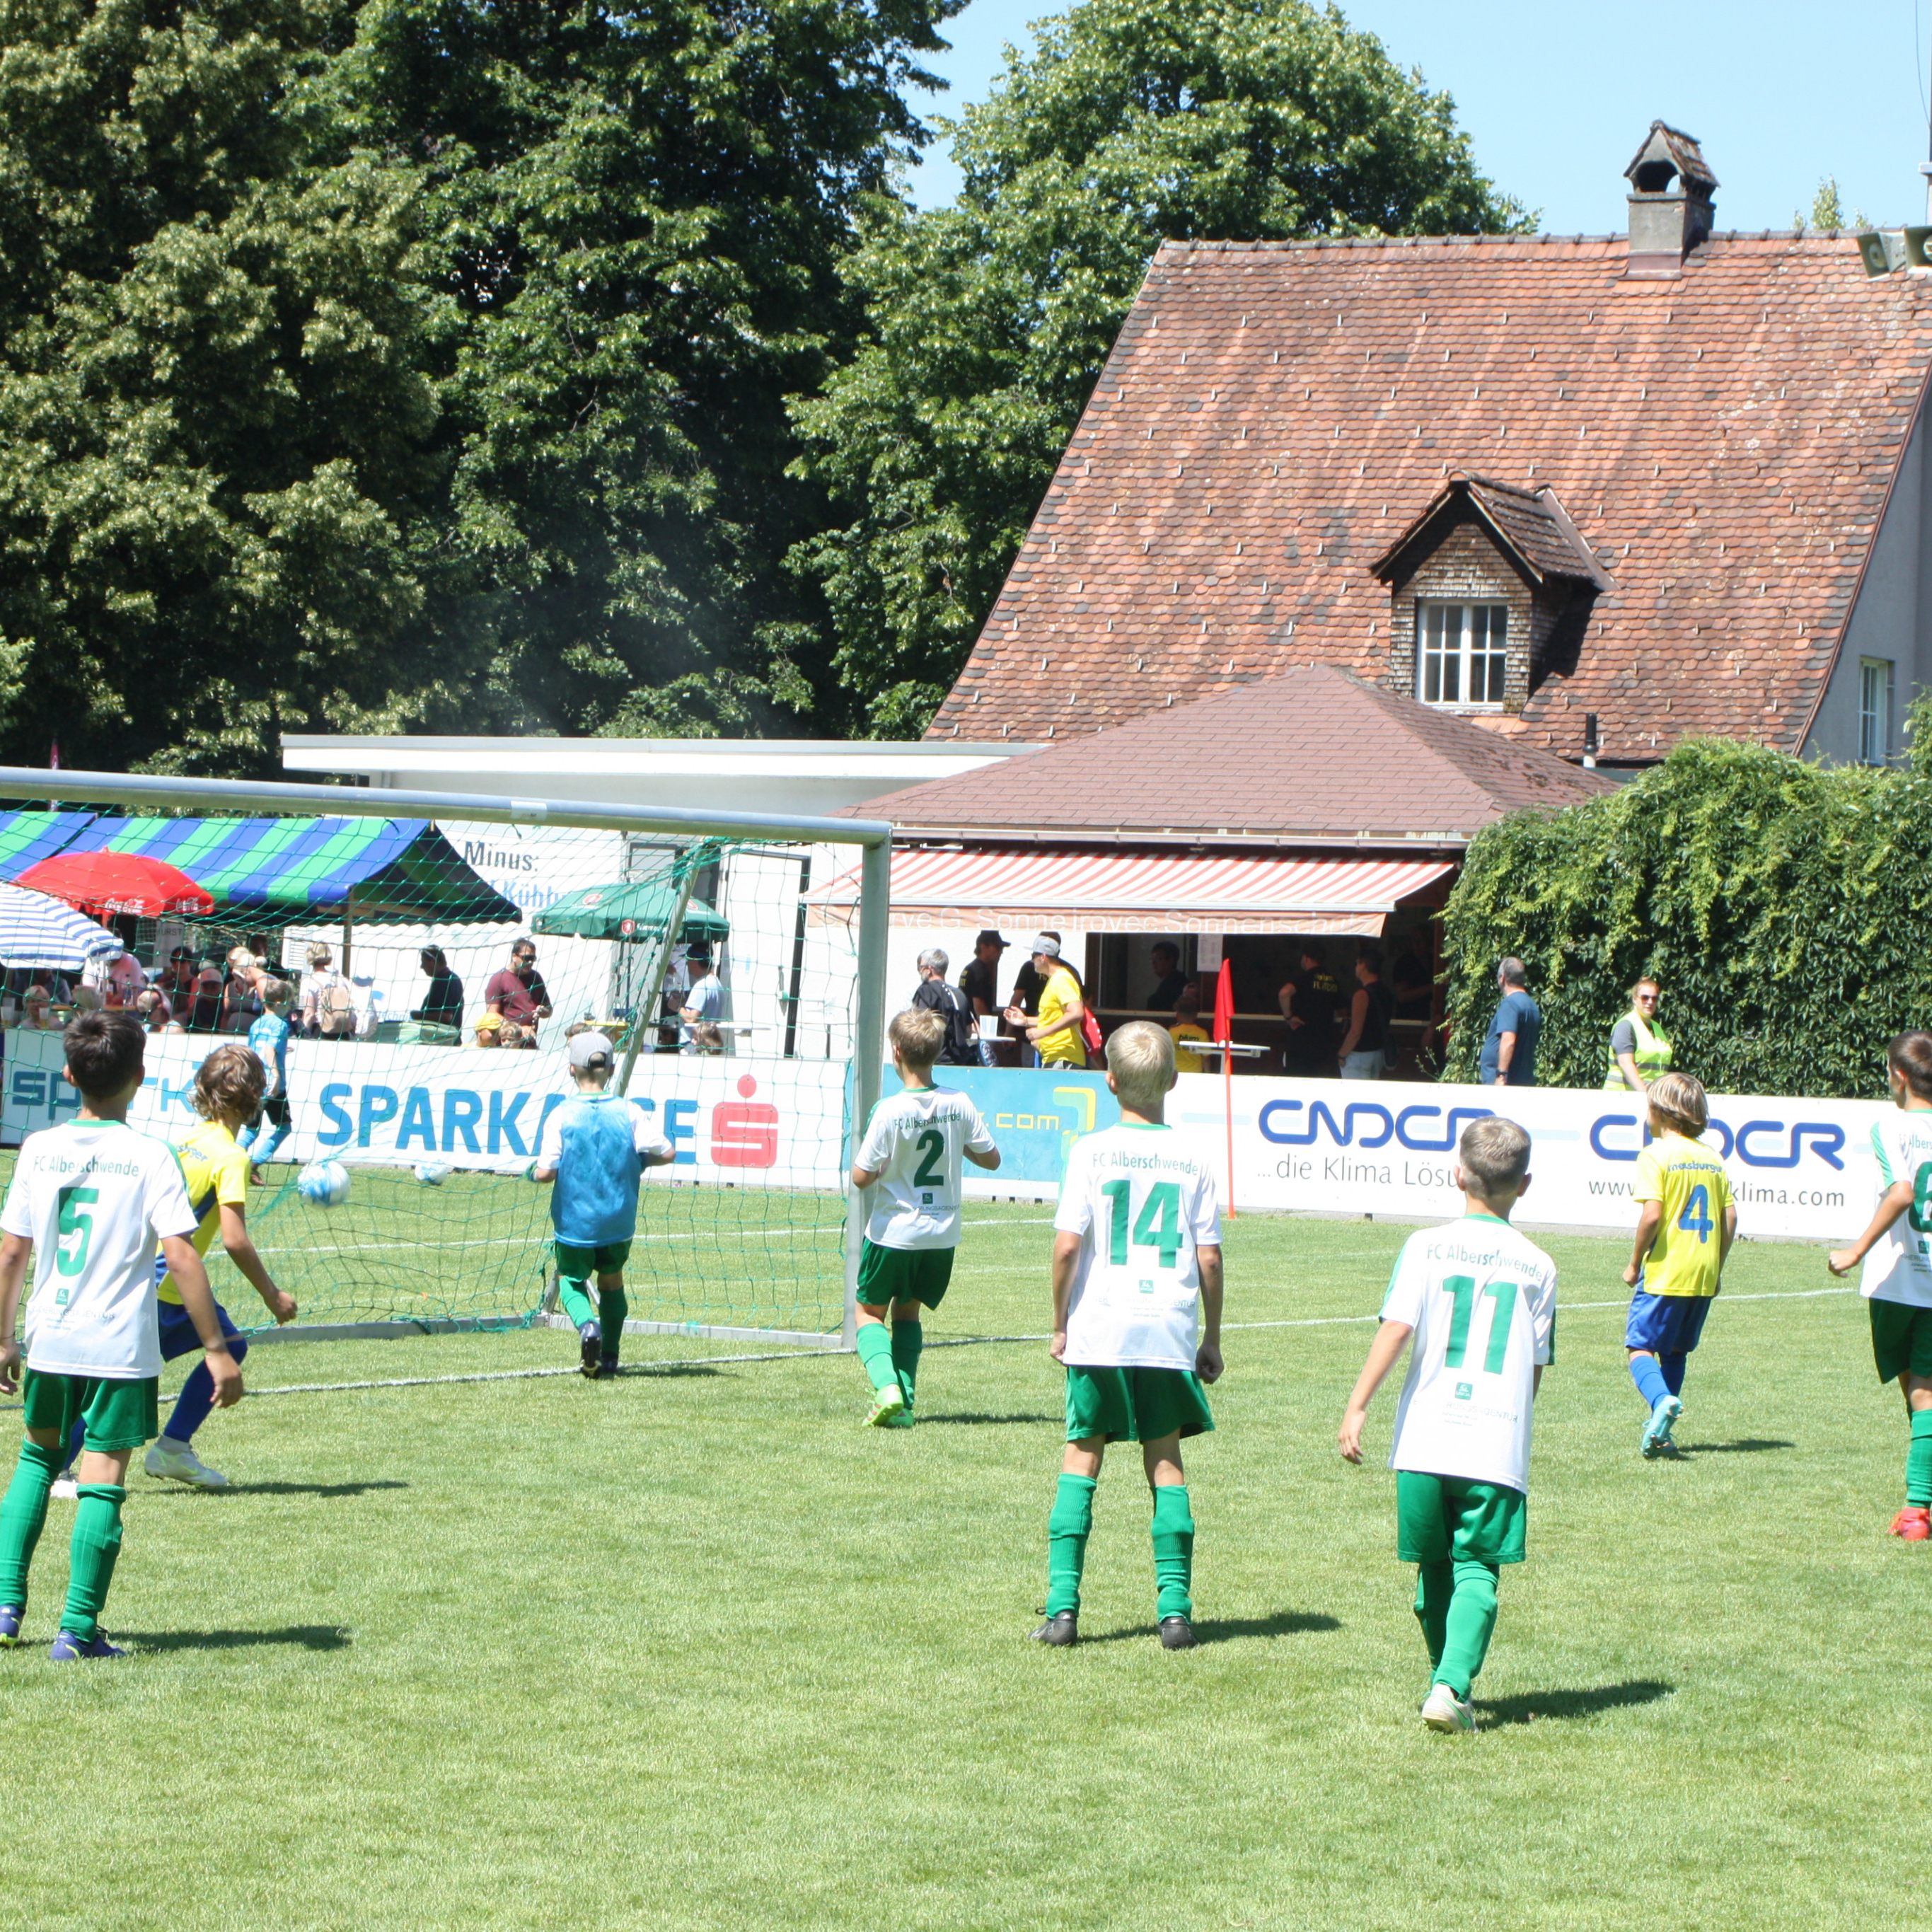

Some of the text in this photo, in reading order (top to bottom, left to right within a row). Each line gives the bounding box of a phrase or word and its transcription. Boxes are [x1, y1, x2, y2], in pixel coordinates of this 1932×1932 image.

[34, 1155, 45, 1172] FC
[914, 1129, 944, 1188] 2
[1093, 1150, 1199, 1176] FC Alberschwende
[1324, 1156, 1392, 1185] Klima
[1404, 1161, 1459, 1188] Lösu
[57, 1186, 99, 1277] 5
[1101, 1179, 1184, 1268] 14
[1678, 1184, 1714, 1244] 4
[1427, 1243, 1543, 1282] FC Alberschwende
[1442, 1274, 1518, 1375] 11
